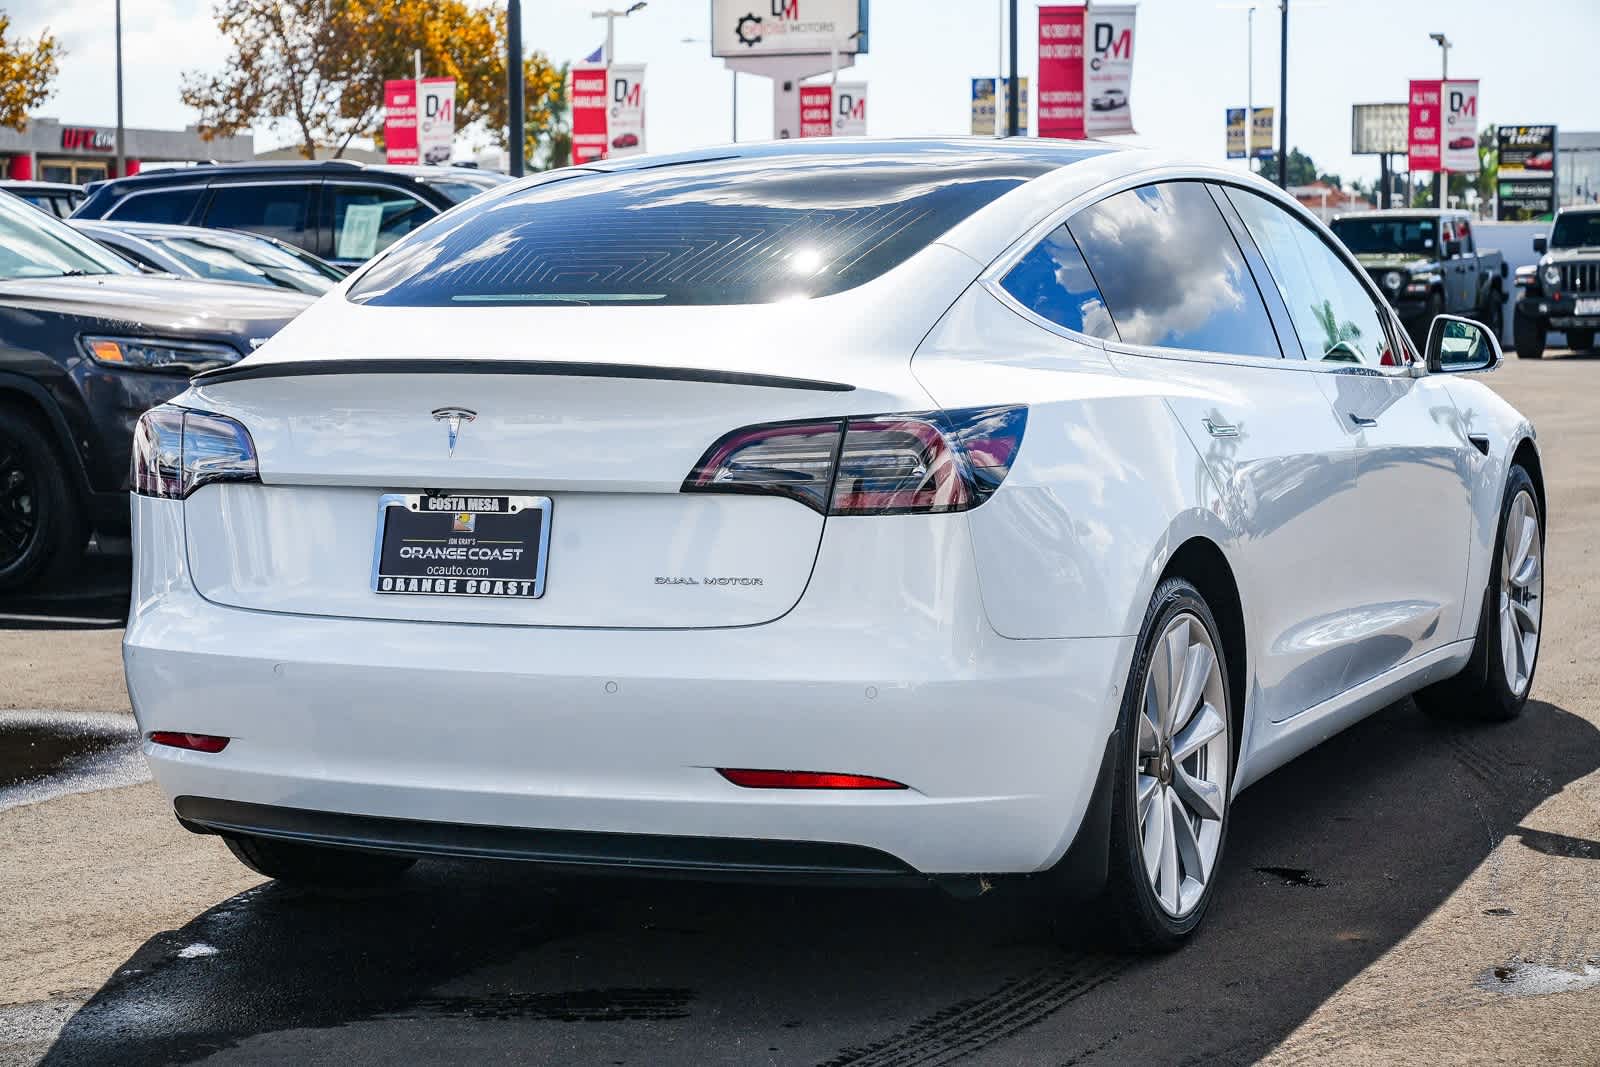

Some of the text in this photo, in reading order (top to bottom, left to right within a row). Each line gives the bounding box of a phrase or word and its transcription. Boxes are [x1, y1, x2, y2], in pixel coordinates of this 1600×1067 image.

[1095, 23, 1131, 59] DM
[1450, 92, 1476, 116] DM
[64, 127, 96, 149] UFC
[428, 497, 500, 511] COSTA MESA
[400, 546, 524, 561] ORANGE COAST
[426, 564, 489, 576] ocauto.com
[382, 577, 531, 595] ORANGE COAST
[654, 576, 765, 586] DUAL MOTOR
